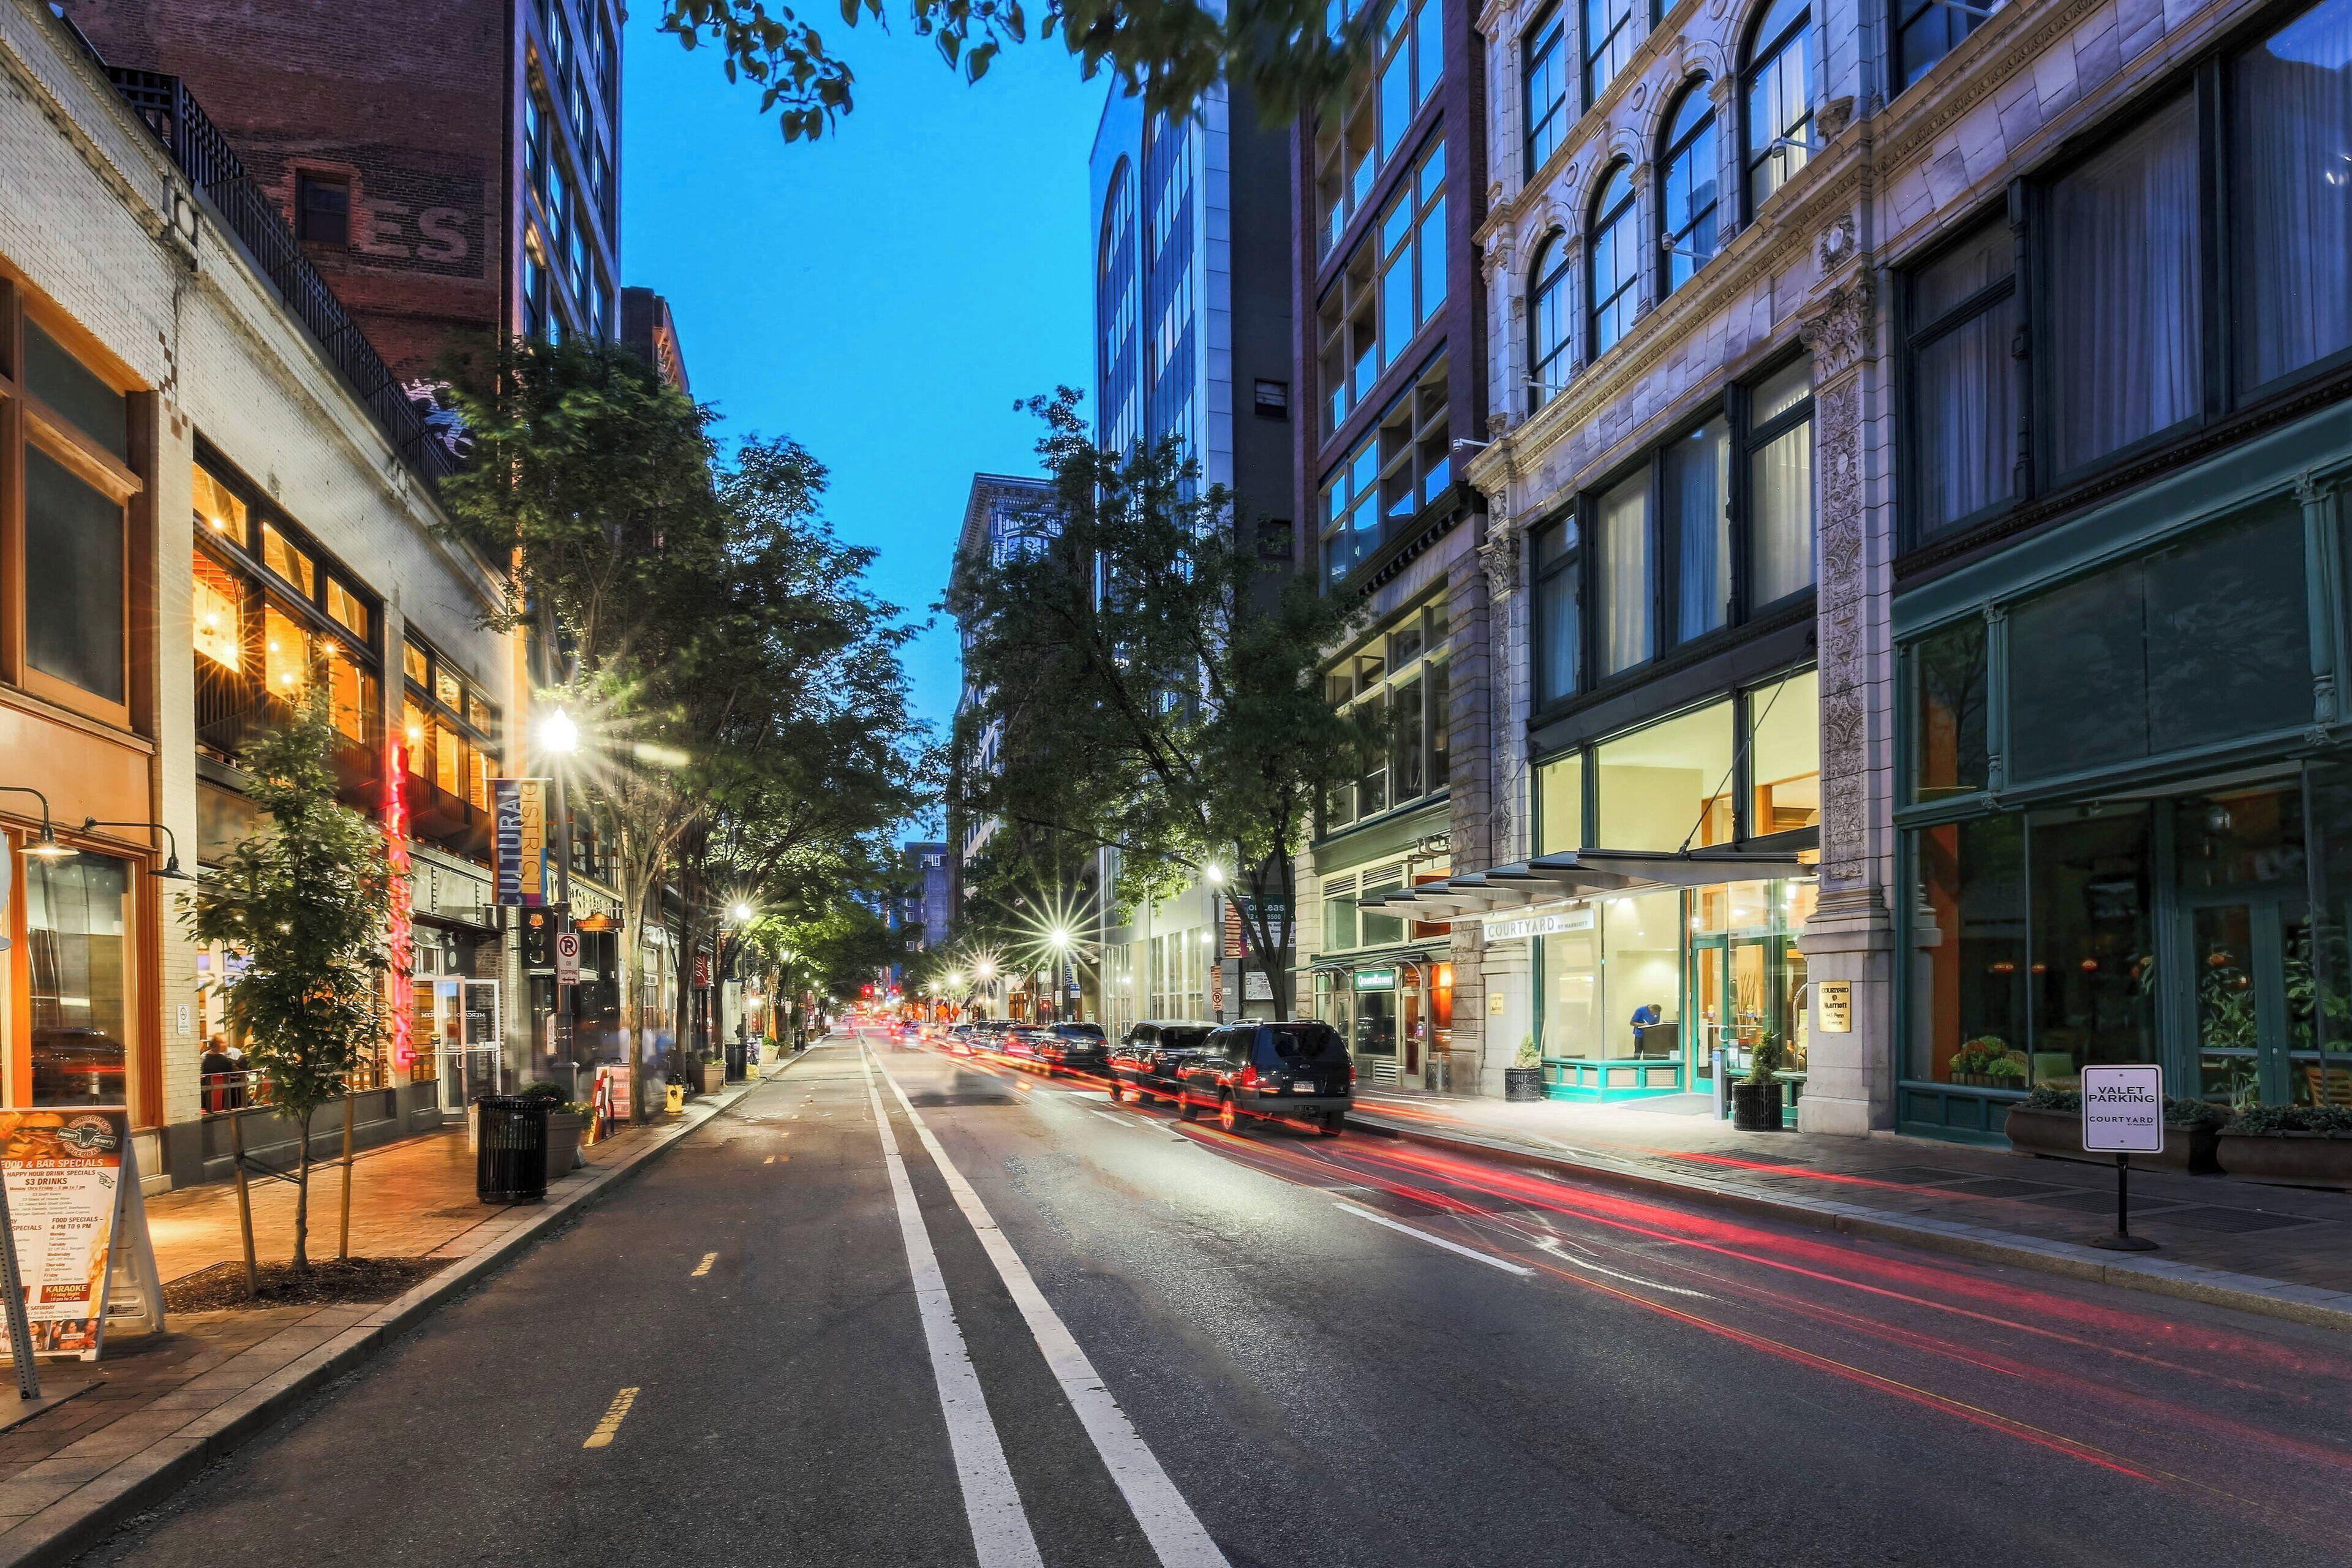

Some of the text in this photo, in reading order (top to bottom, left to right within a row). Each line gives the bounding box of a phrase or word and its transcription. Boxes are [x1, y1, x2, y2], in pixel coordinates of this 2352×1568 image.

[521, 782, 541, 891] DISTRICT
[497, 782, 523, 906] CULTURAL
[1488, 918, 1555, 938] COURTYARD
[1564, 921, 1588, 929] MARRIOTT
[2089, 1095, 2155, 1103] PARKING
[93, 1137, 114, 1145] HENRY'S
[62, 1141, 102, 1158] BURGER BAR
[26, 1160, 34, 1169] &
[36, 1159, 55, 1168] BAR
[58, 1158, 104, 1167] SPECIALS
[46, 1284, 88, 1293] KARAOKE
